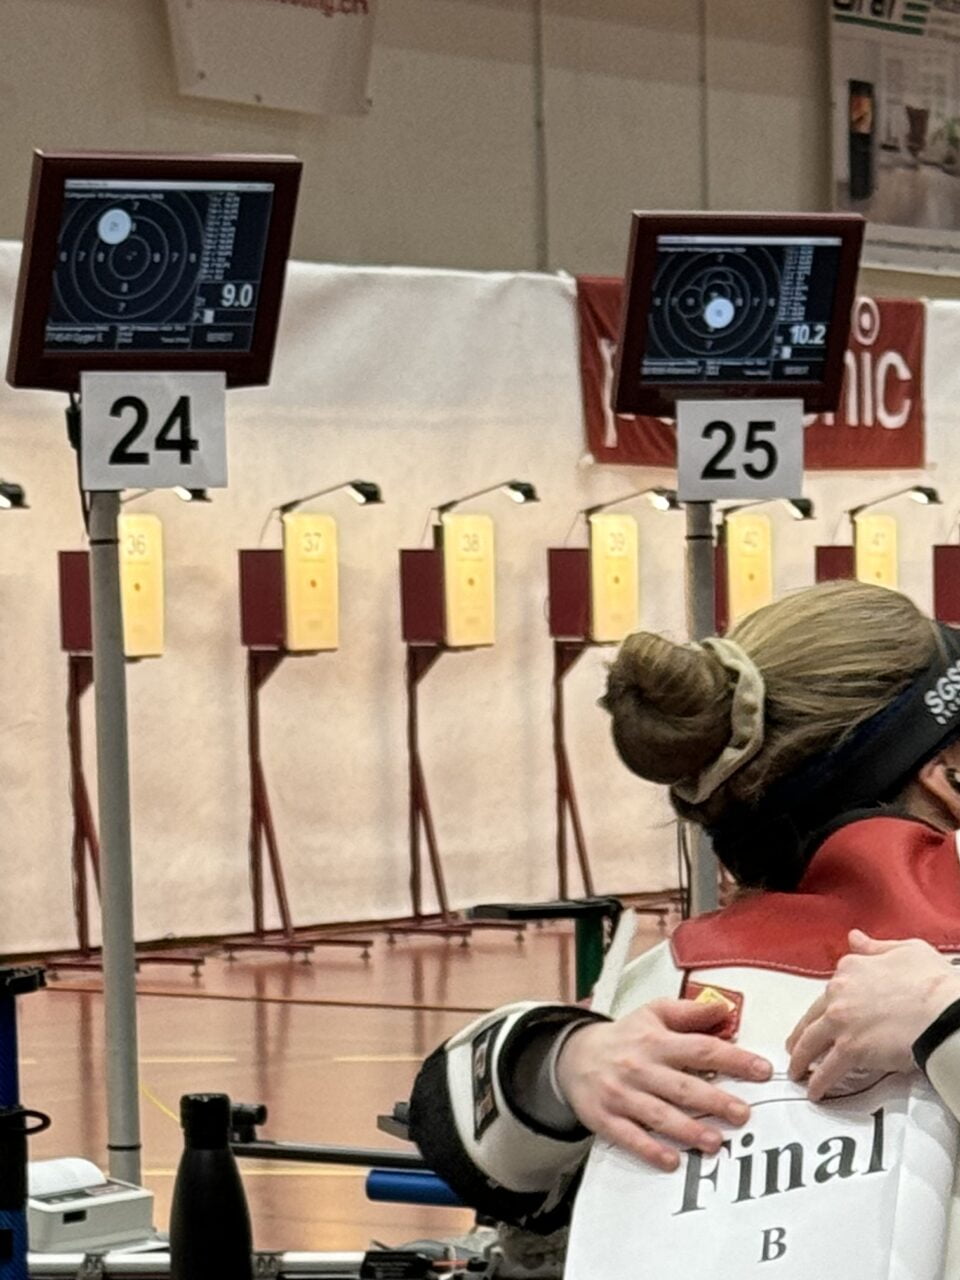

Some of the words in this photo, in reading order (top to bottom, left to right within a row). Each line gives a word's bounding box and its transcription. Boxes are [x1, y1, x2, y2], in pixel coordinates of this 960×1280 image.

[221, 283, 254, 307] 9.0
[790, 325, 826, 345] 10.2
[109, 396, 199, 465] 24
[700, 421, 779, 481] 25
[671, 1106, 889, 1216] Final
[757, 1226, 788, 1264] B
